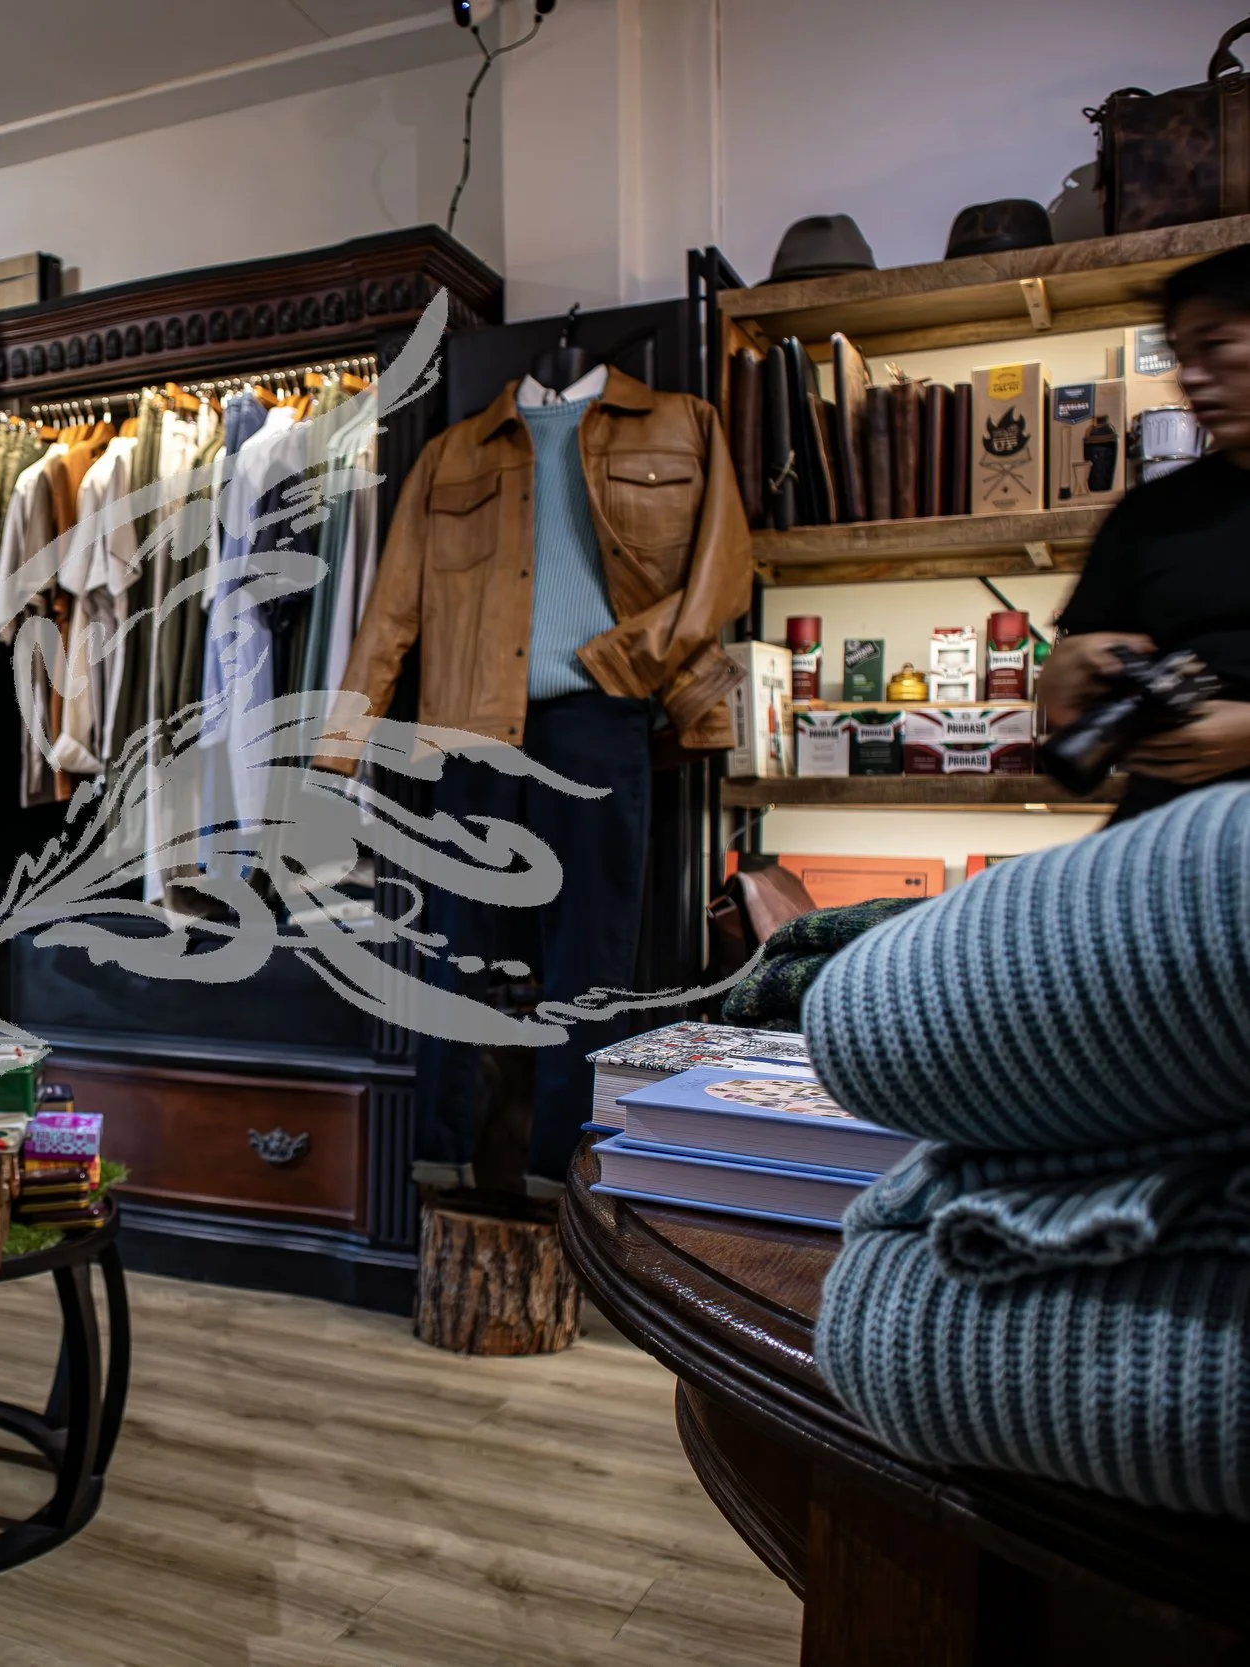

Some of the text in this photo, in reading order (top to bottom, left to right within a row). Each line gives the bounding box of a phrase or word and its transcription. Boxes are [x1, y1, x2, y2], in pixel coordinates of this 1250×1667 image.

[860, 729, 890, 738] PRORASO
[946, 722, 986, 734] PRORASO
[809, 729, 839, 739] PRORASO
[948, 755, 987, 767] PRORASO
